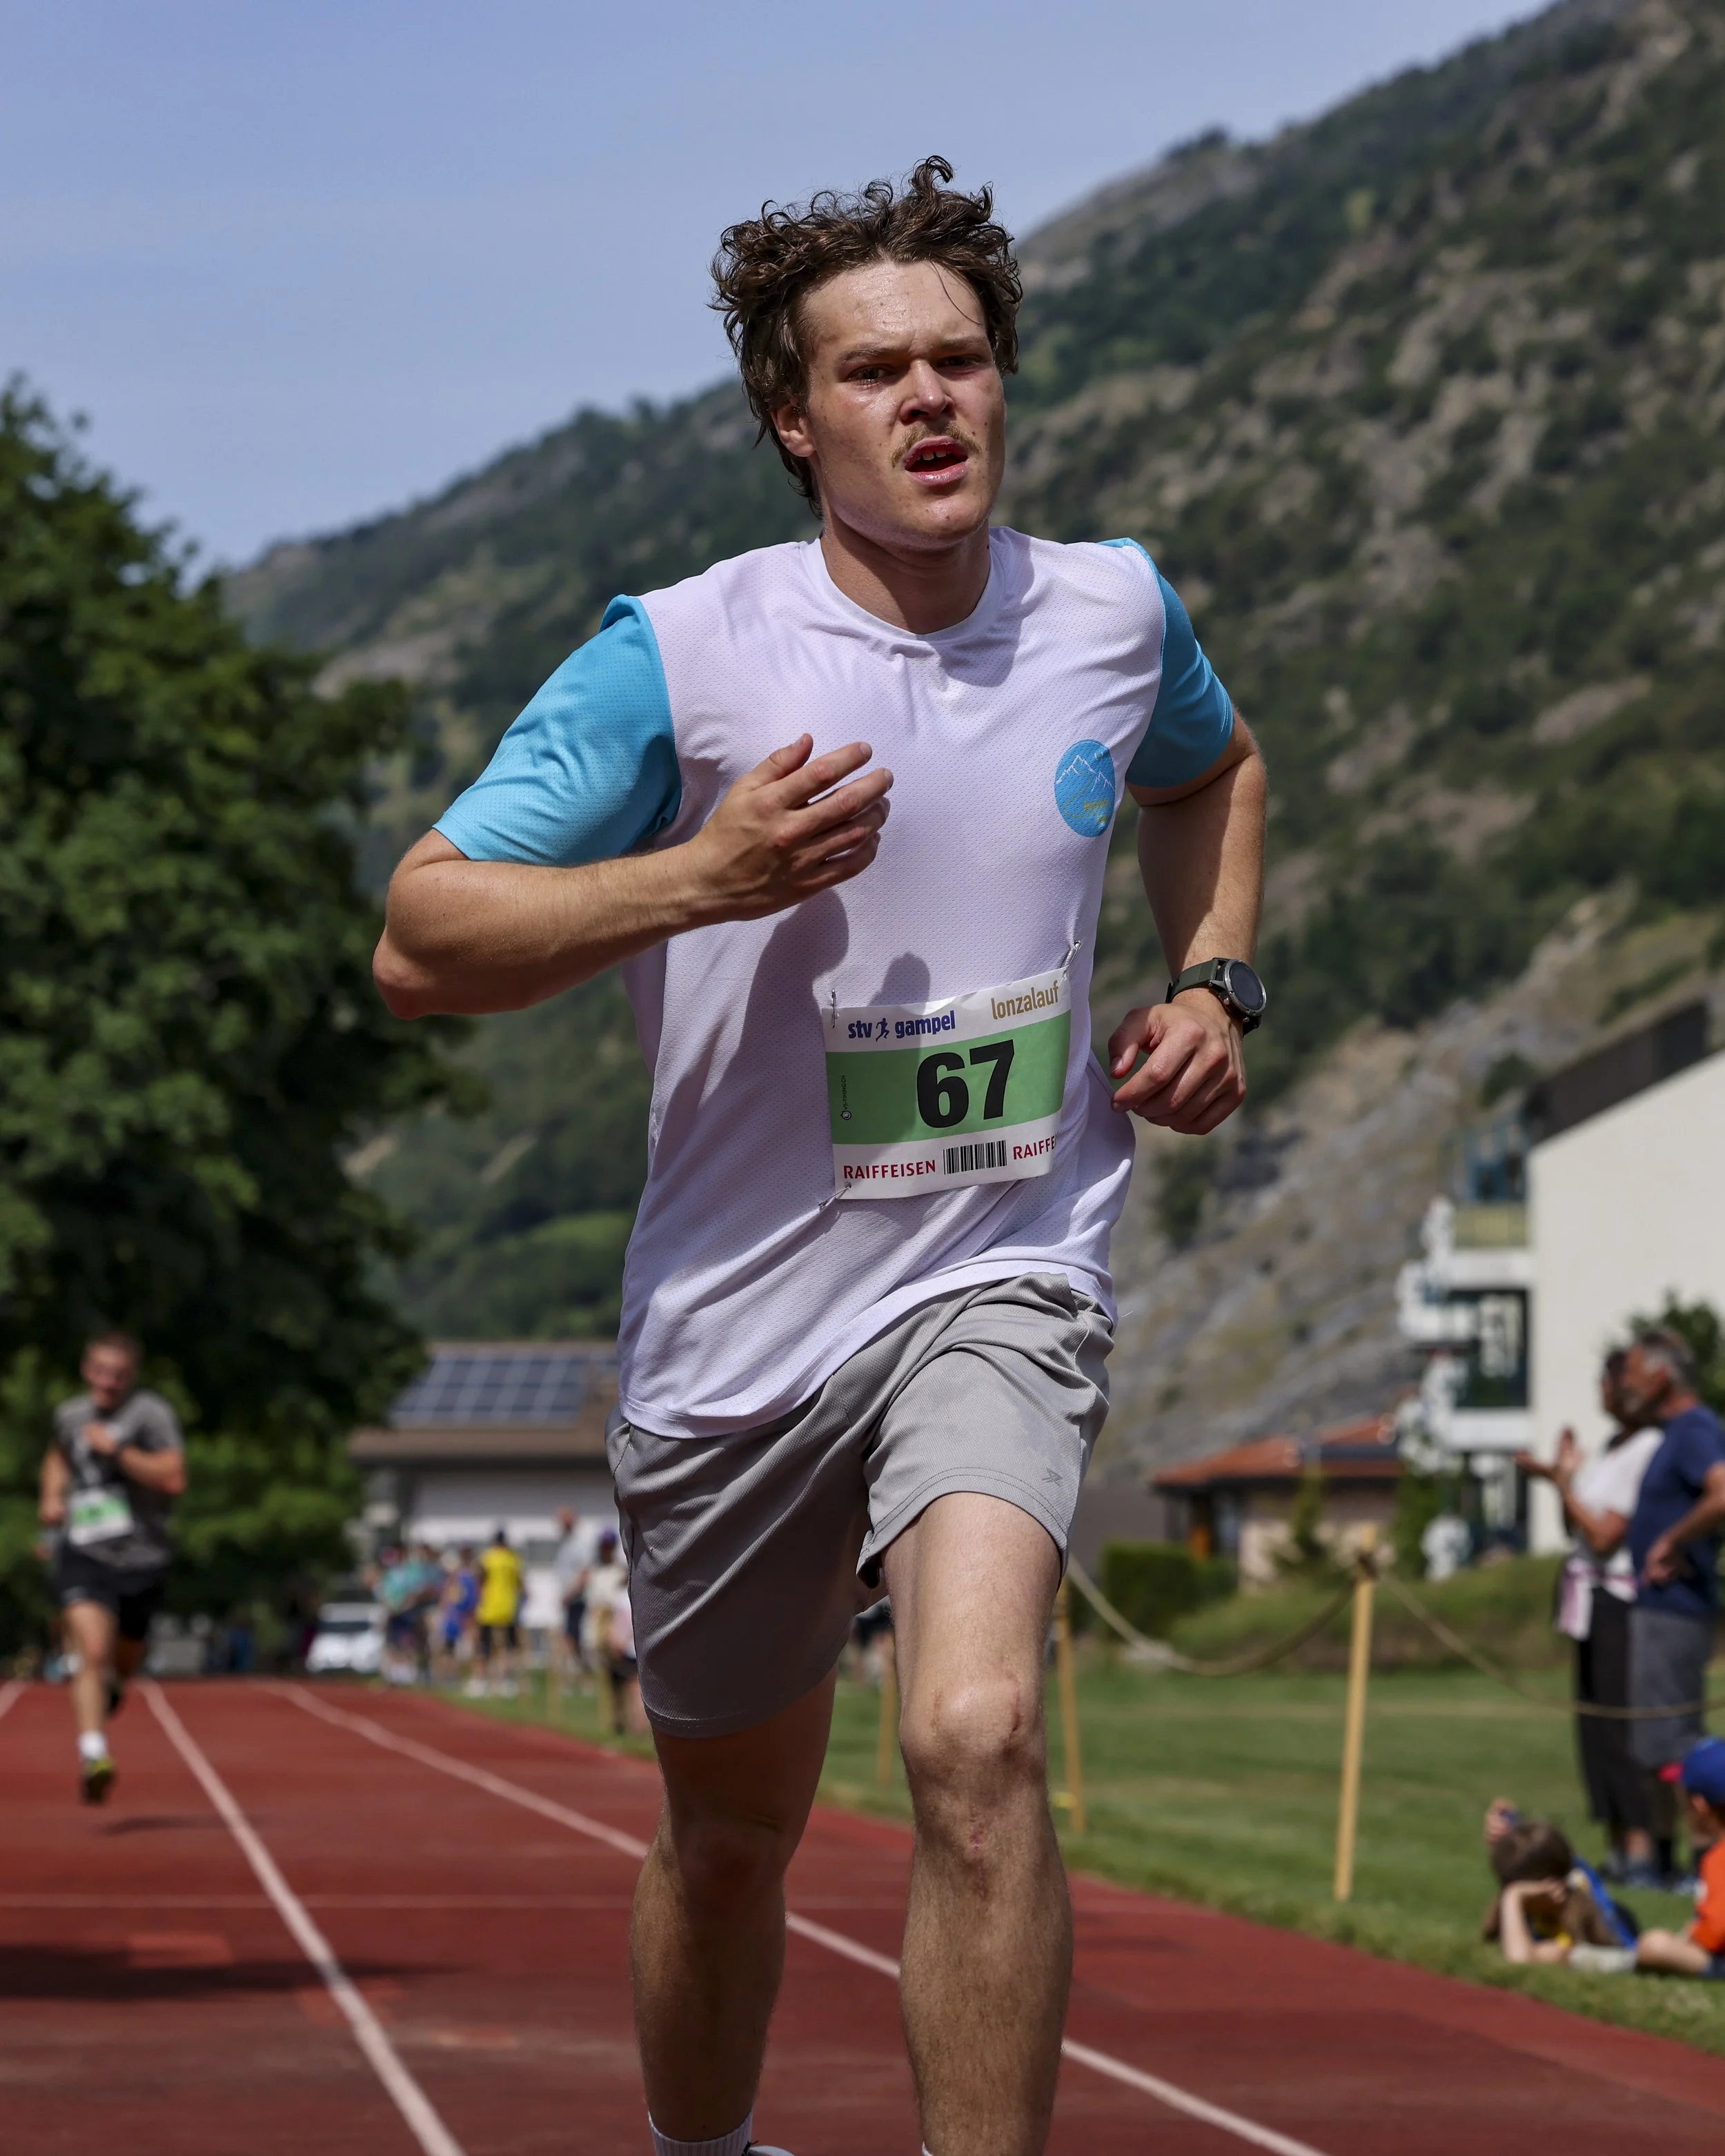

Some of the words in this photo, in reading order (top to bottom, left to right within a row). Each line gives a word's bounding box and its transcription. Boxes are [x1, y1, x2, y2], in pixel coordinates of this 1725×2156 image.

[991, 980, 1058, 1020] lonzalauf
[848, 1020, 872, 1038] stv
[895, 1010, 956, 1038] gampel
[916, 1039, 1015, 1129] 67
[843, 1160, 936, 1179] RAIFFEISEN
